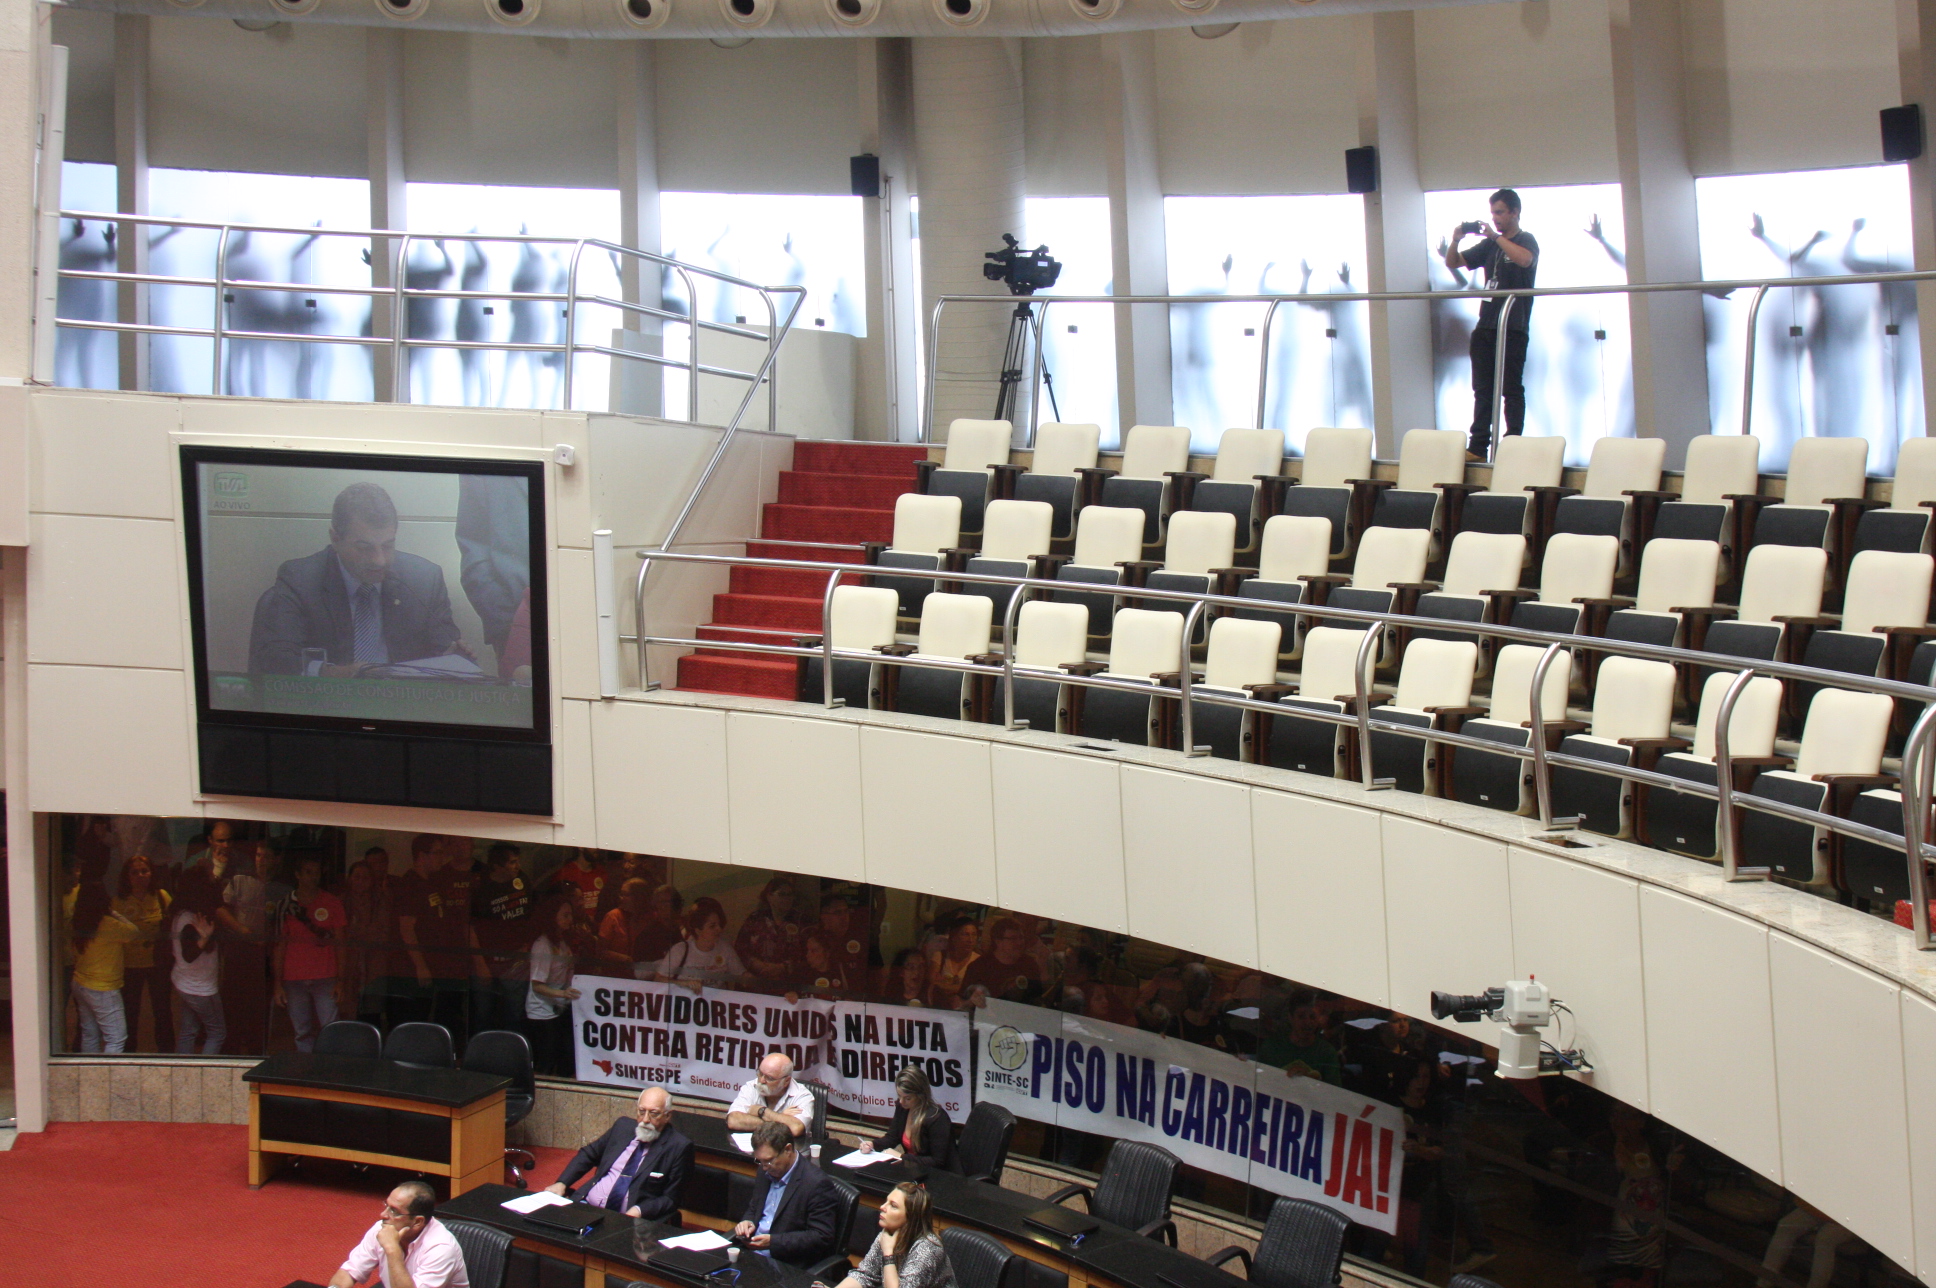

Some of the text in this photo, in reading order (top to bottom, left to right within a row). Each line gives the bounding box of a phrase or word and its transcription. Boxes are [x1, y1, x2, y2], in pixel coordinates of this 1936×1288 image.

[213, 500, 251, 510] AO VIVO
[336, 682, 354, 697] DE
[468, 690, 520, 706] JUSTIÇA
[501, 907, 525, 921] VALER
[594, 988, 758, 1034] SERVIDORES
[844, 1013, 880, 1046] NA
[885, 1016, 948, 1053] LUTA
[582, 1020, 689, 1060] CONTRA
[615, 1063, 682, 1085] SINTESPE
[984, 1070, 1029, 1089] SINTE-SC
[690, 1075, 732, 1091] Sindicato
[852, 1093, 886, 1107] Público
[945, 1102, 960, 1112] SC
[1031, 1034, 1395, 1215] PISO NA CARREIRA JÁ!
